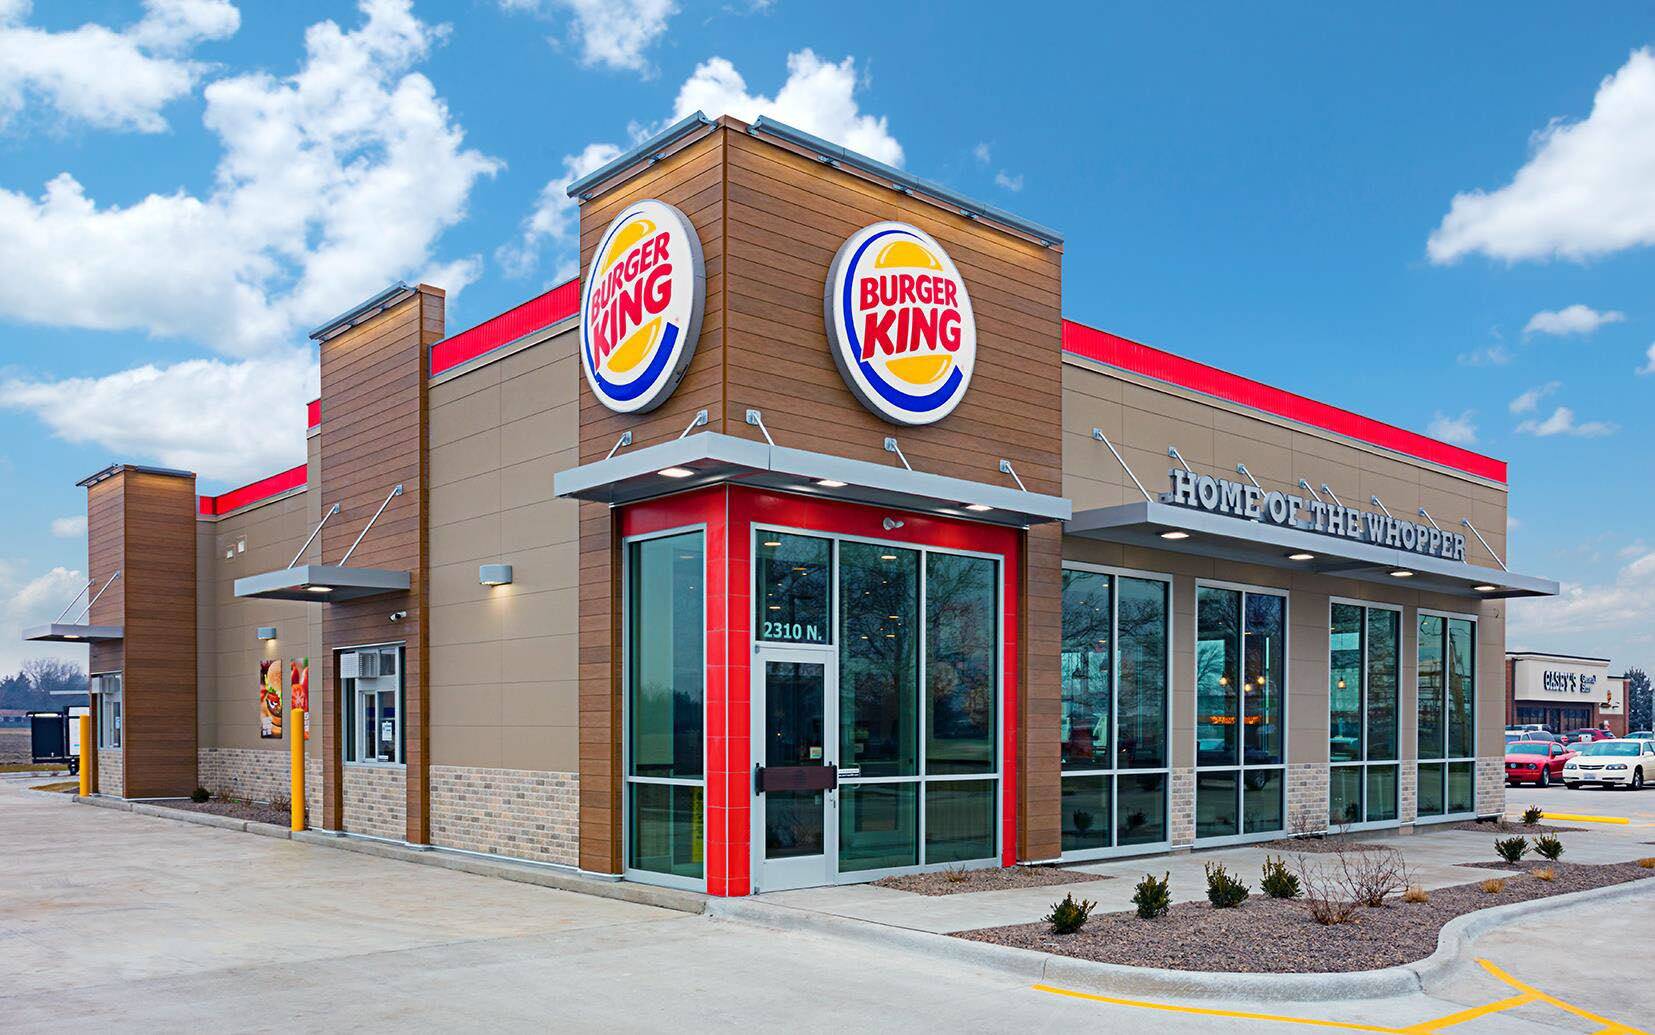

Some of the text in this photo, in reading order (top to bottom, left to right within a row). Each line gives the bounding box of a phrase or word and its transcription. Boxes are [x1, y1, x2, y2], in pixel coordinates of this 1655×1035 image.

[591, 232, 671, 327] BURGER
[860, 274, 957, 311] BURGER
[592, 263, 672, 370] KING
[862, 308, 961, 360] KING
[1170, 469, 1467, 561] HOME OF THE WHOPPER
[763, 621, 823, 641] 2310 N.
